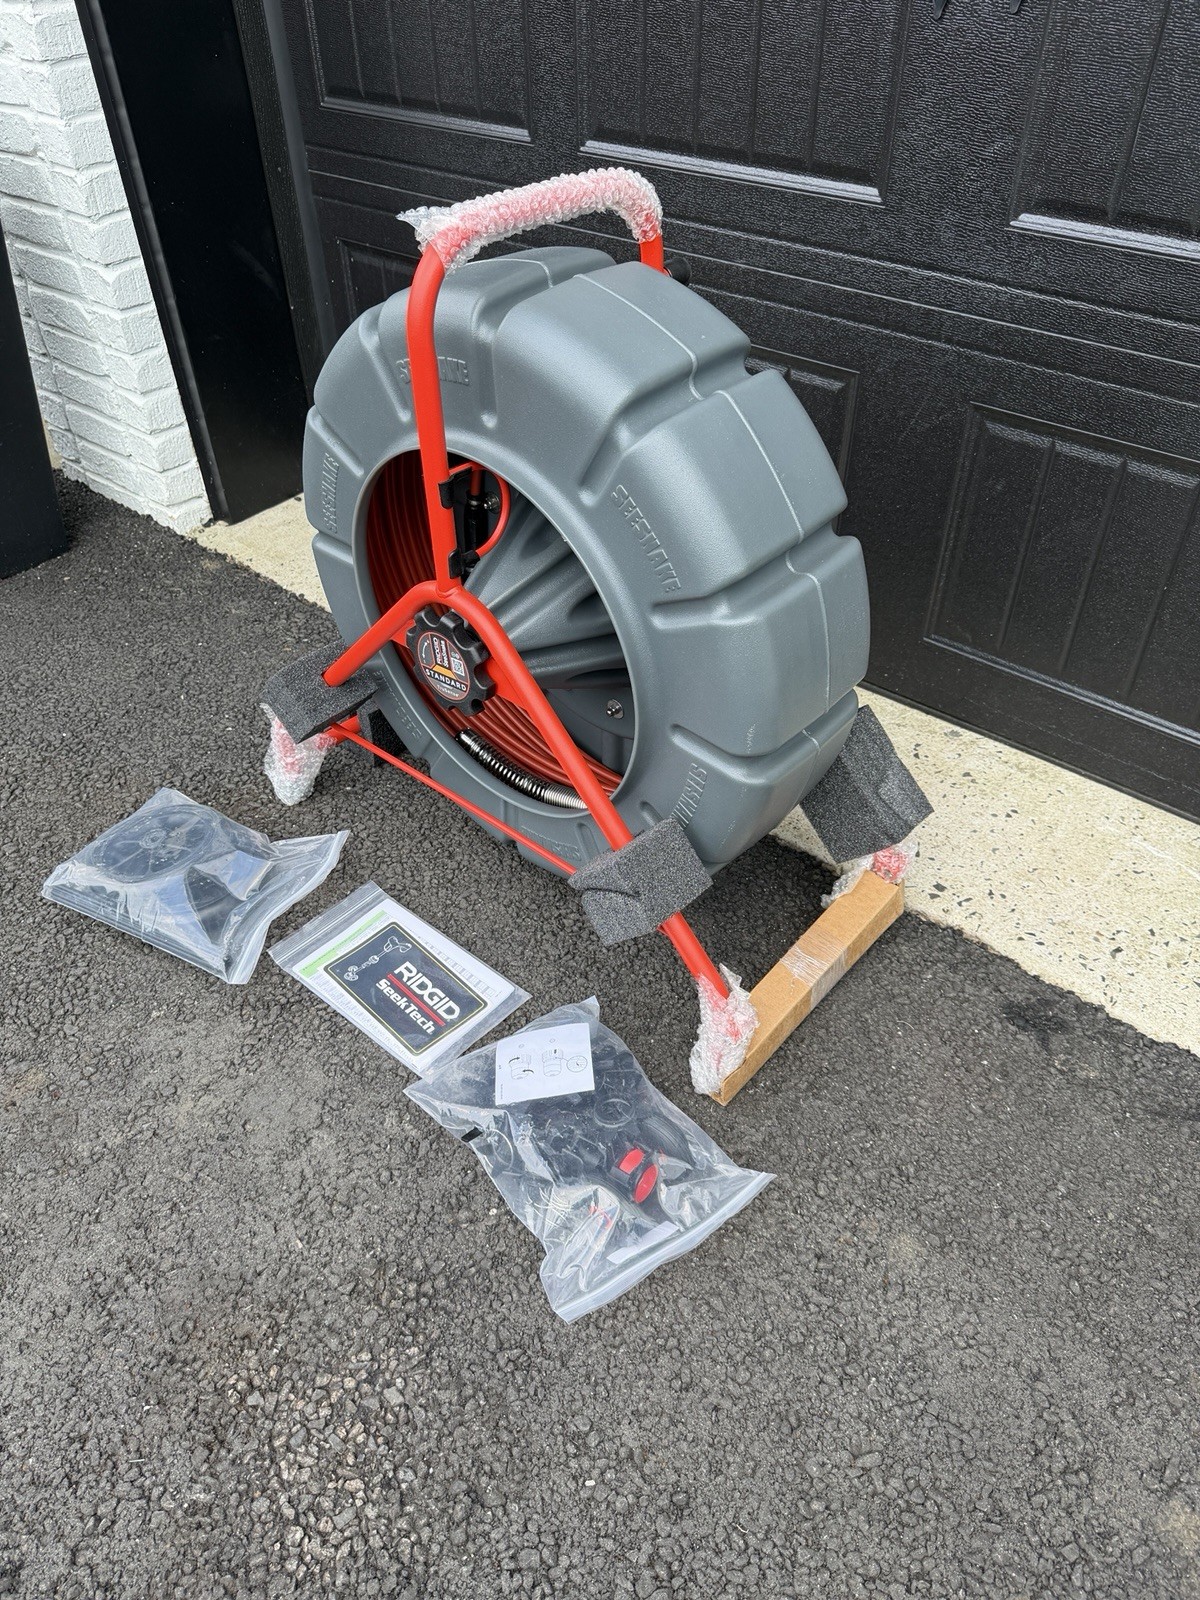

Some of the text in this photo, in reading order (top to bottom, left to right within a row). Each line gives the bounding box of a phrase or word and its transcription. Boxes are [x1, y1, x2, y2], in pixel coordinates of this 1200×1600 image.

[611, 484, 681, 594] SEESNAKE
[425, 668, 467, 692] STANDARD
[668, 762, 708, 832] SEESNAK
[375, 978, 436, 1035] SeekTech
[393, 960, 460, 1020] RIDGID
